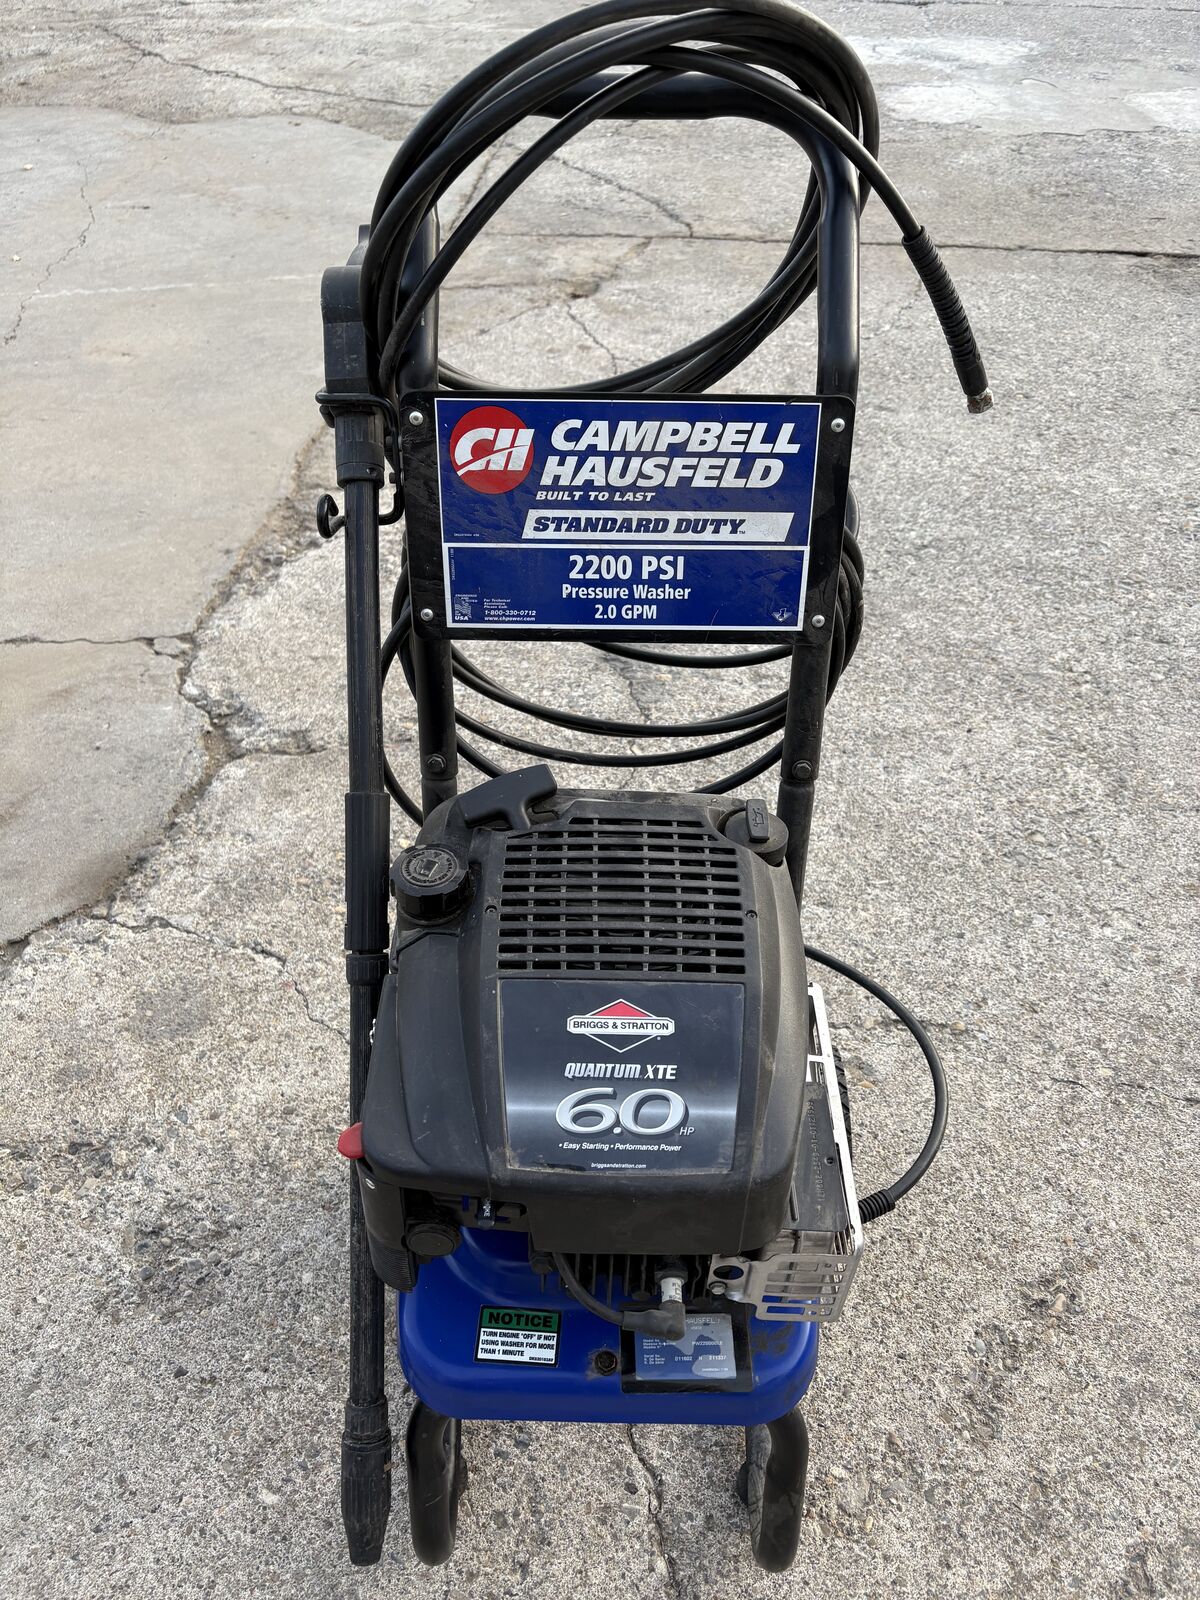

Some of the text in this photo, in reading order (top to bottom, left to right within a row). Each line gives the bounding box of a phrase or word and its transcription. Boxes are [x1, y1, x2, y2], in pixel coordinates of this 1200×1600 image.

[550, 419, 800, 454] CAMPBELL
[539, 456, 784, 489] HAUSFELD
[536, 491, 656, 502] BUILT TO LAST
[533, 516, 670, 534] STANDARD
[569, 555, 685, 580] 2200 PSI
[562, 584, 691, 600] Pressure Washer
[594, 604, 657, 620] 2.0 GPM
[573, 1020, 609, 1029] BRIGGS
[620, 1022, 669, 1030] STRATTON
[564, 1062, 678, 1080] QUANTUM XTE
[556, 1087, 694, 1136] 6.0 HP
[563, 1142, 581, 1150] Easy
[582, 1142, 609, 1151] Starting
[615, 1143, 658, 1151] Performance
[488, 1312, 553, 1328] NOTICE
[500, 1340, 524, 1348] WASHER
